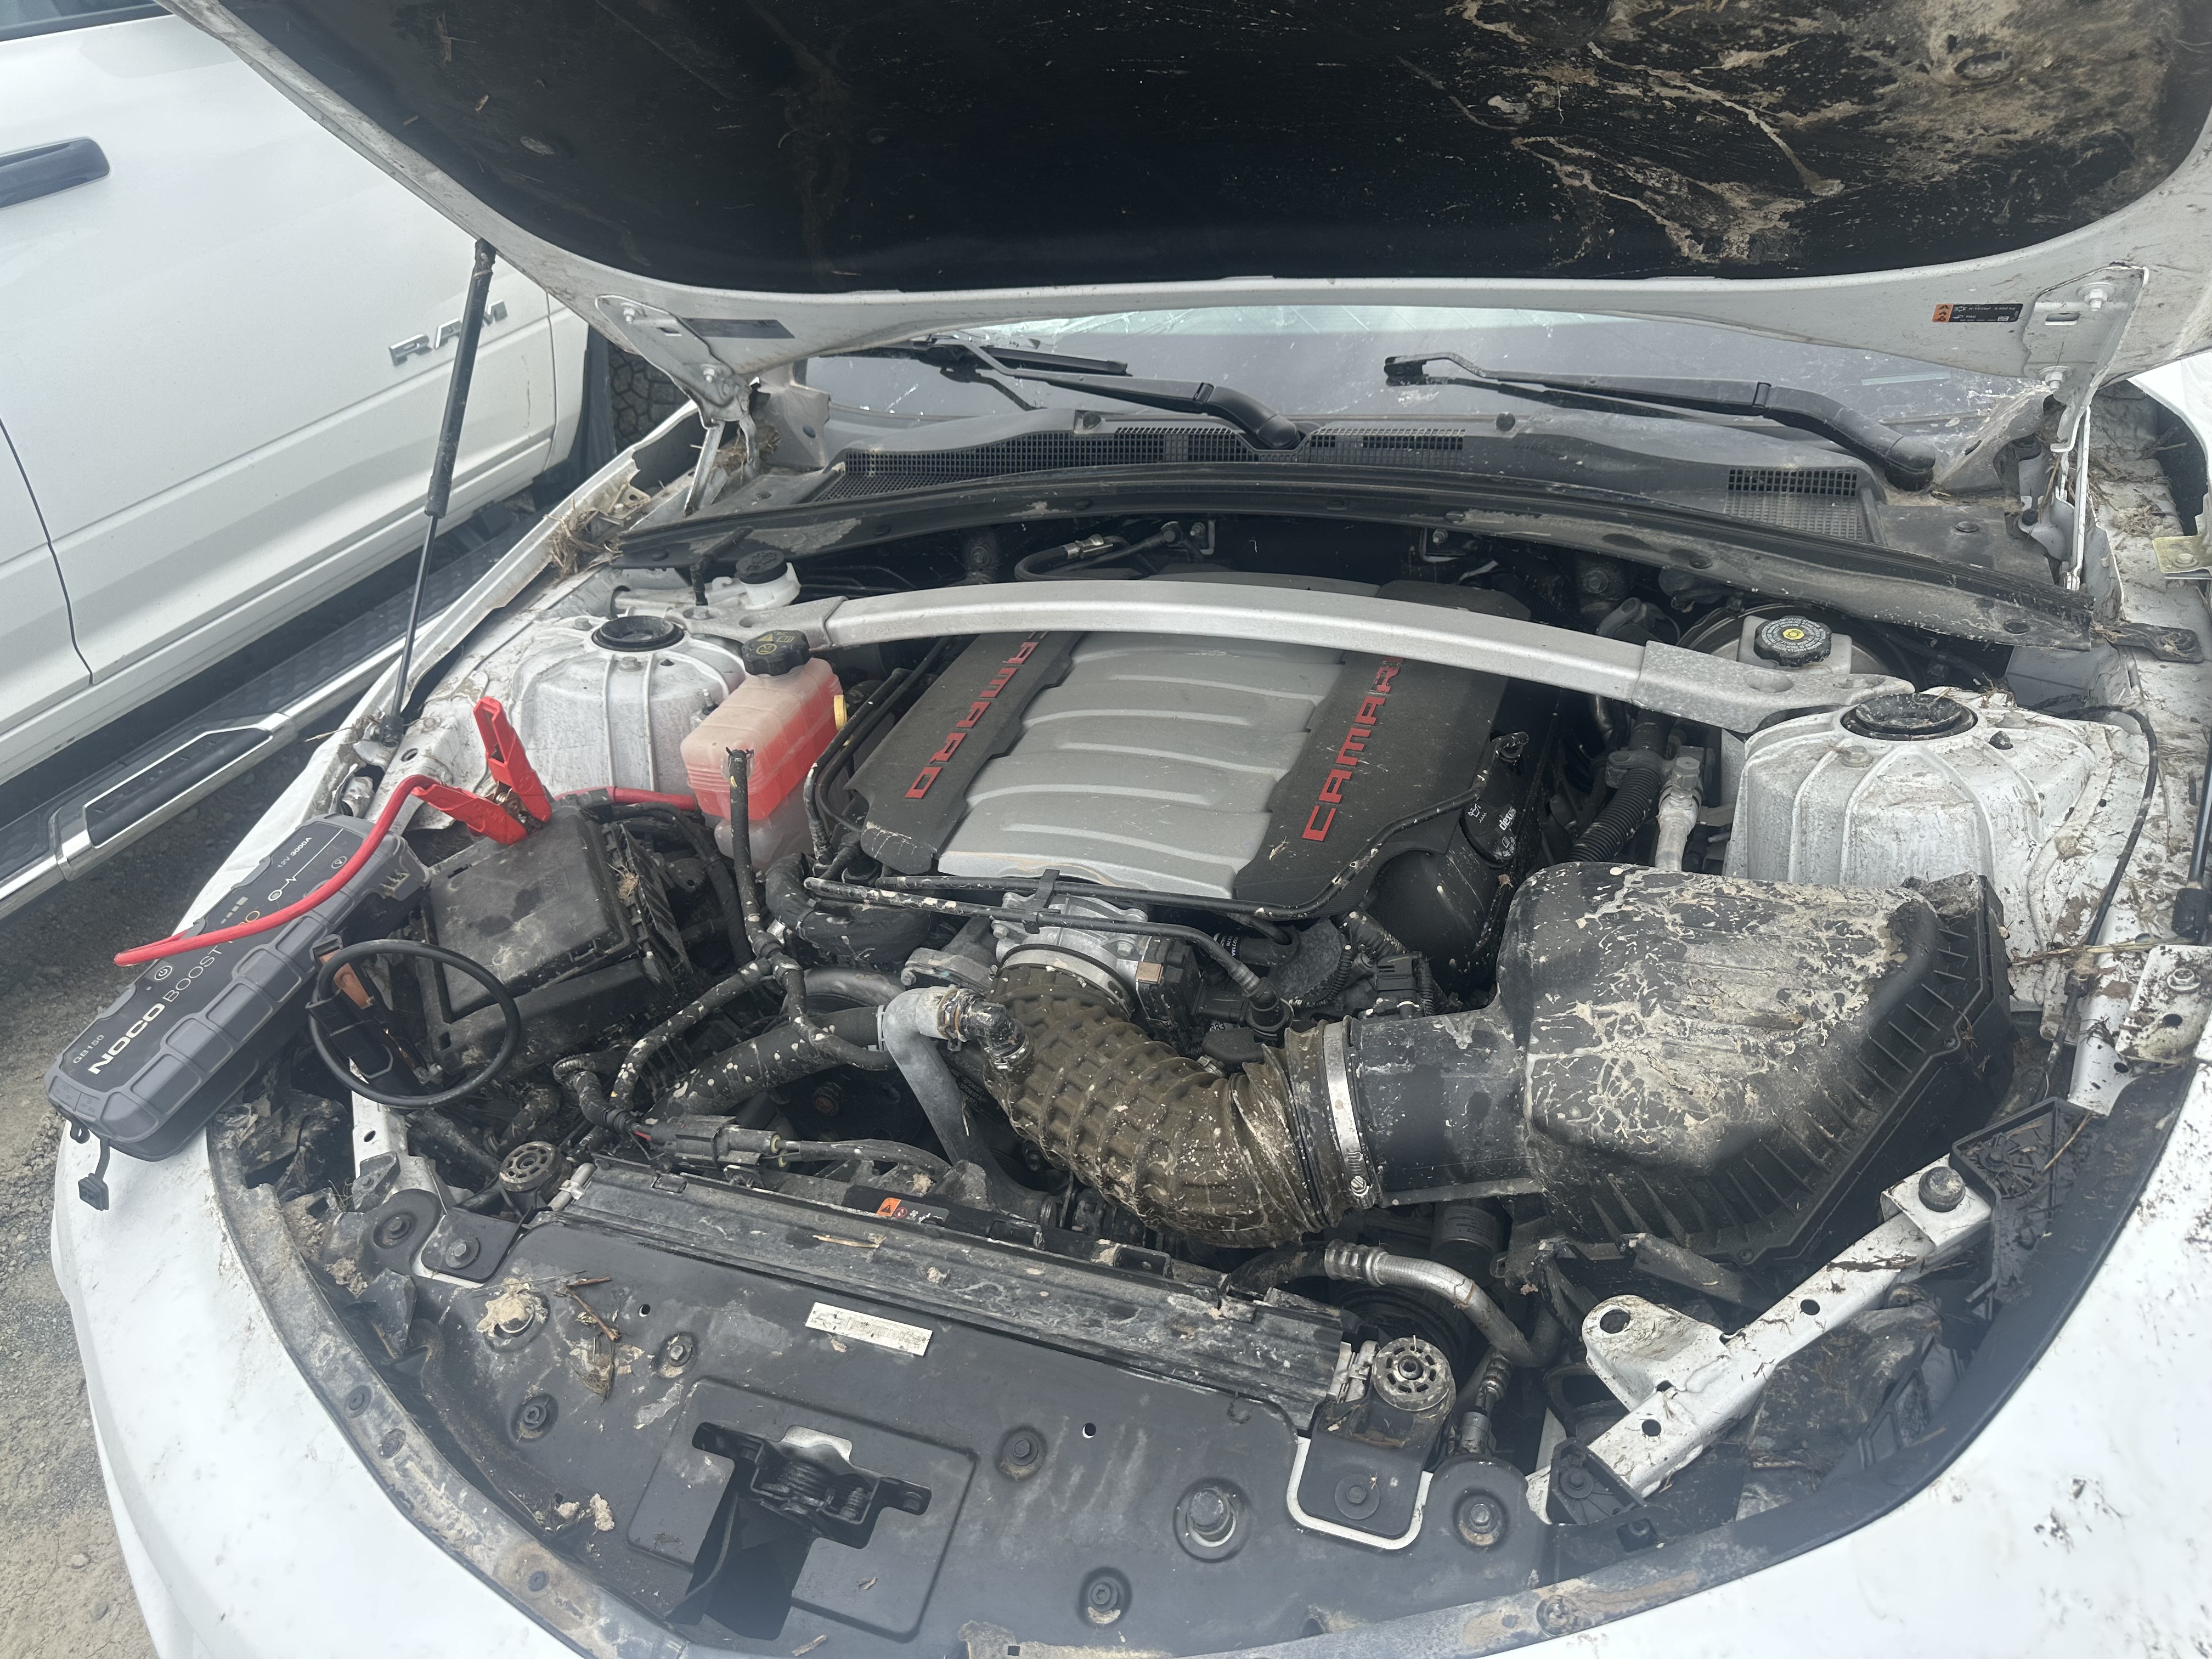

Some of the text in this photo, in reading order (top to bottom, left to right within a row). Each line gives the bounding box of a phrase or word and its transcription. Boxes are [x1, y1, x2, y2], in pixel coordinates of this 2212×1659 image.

[905, 631, 1049, 799] AMARO
[1302, 657, 1404, 842] CAMAR
[1499, 808, 1516, 831] dexos
[277, 837, 313, 868] 12V 3000A
[162, 945, 222, 1002] BOOST
[73, 1035, 104, 1064] GB150
[88, 1003, 165, 1074] NOCO
